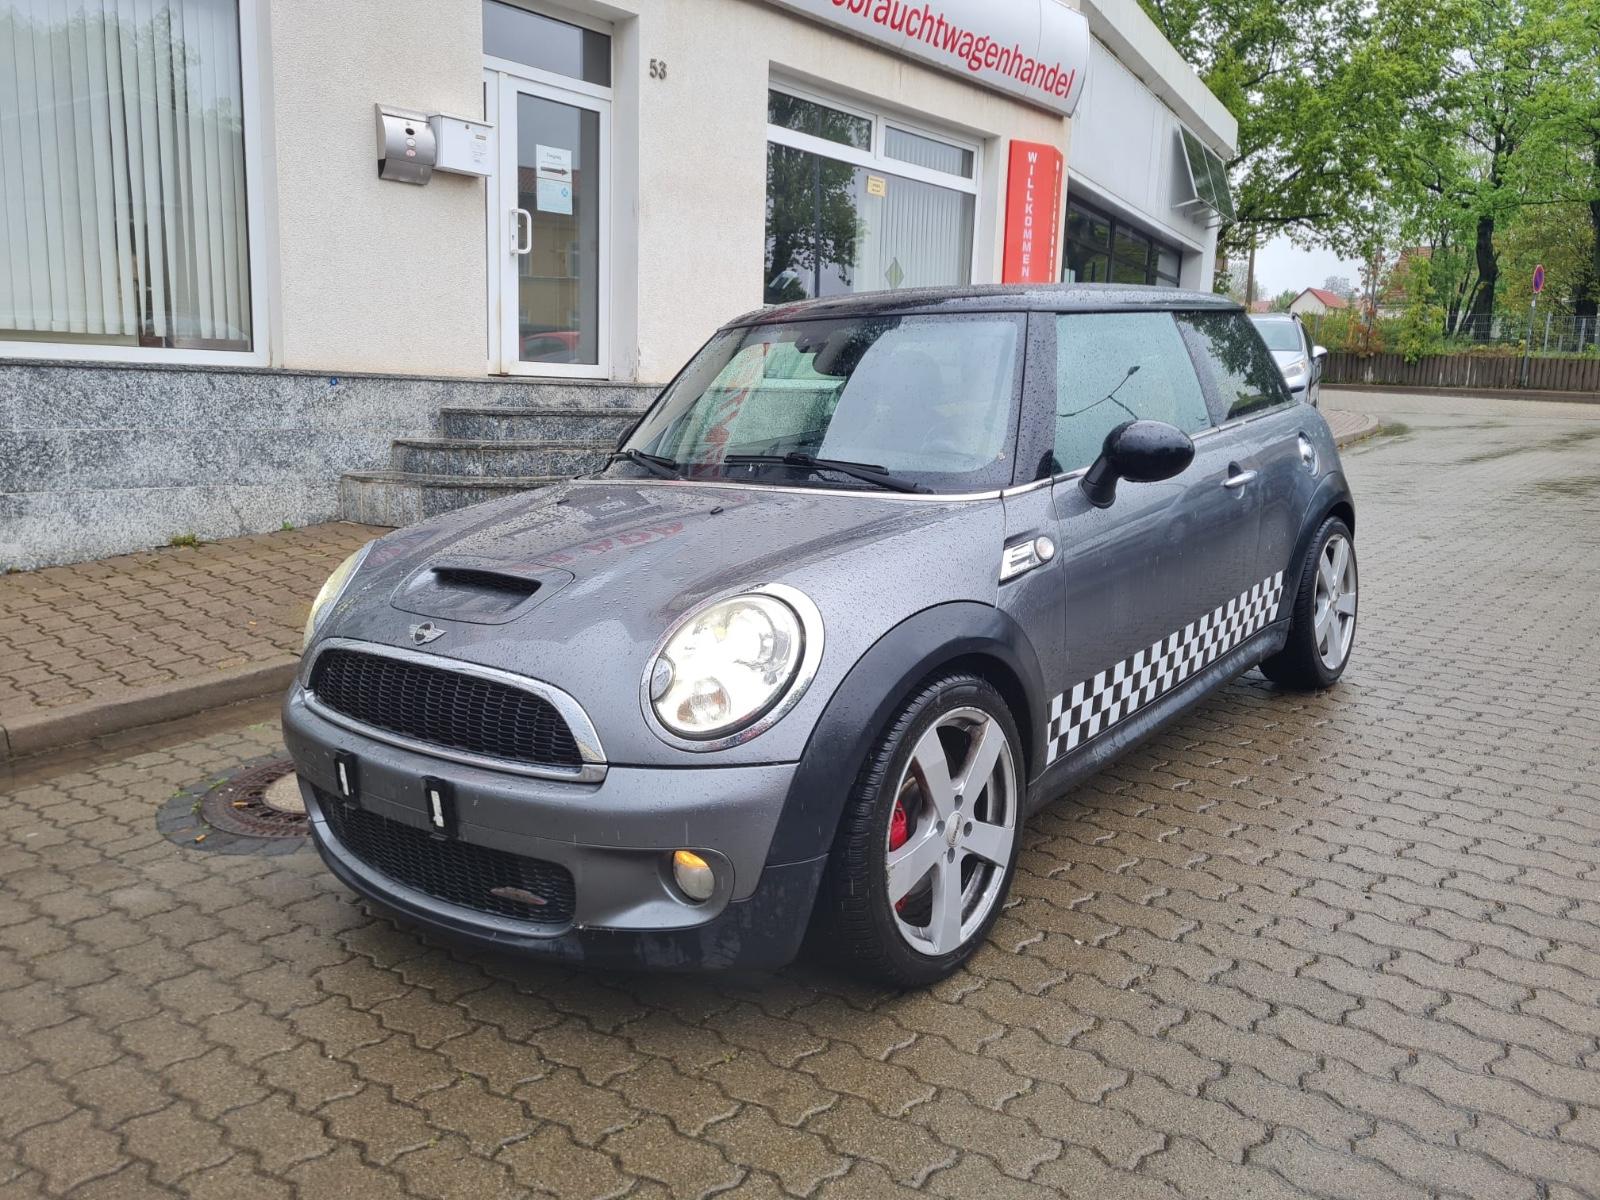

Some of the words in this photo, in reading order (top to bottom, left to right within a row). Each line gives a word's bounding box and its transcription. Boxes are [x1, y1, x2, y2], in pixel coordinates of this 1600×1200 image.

[649, 58, 667, 80] 53
[831, 0, 1075, 99] rauchtwagenhandel
[1021, 151, 1038, 277] WILLKOMMEN
